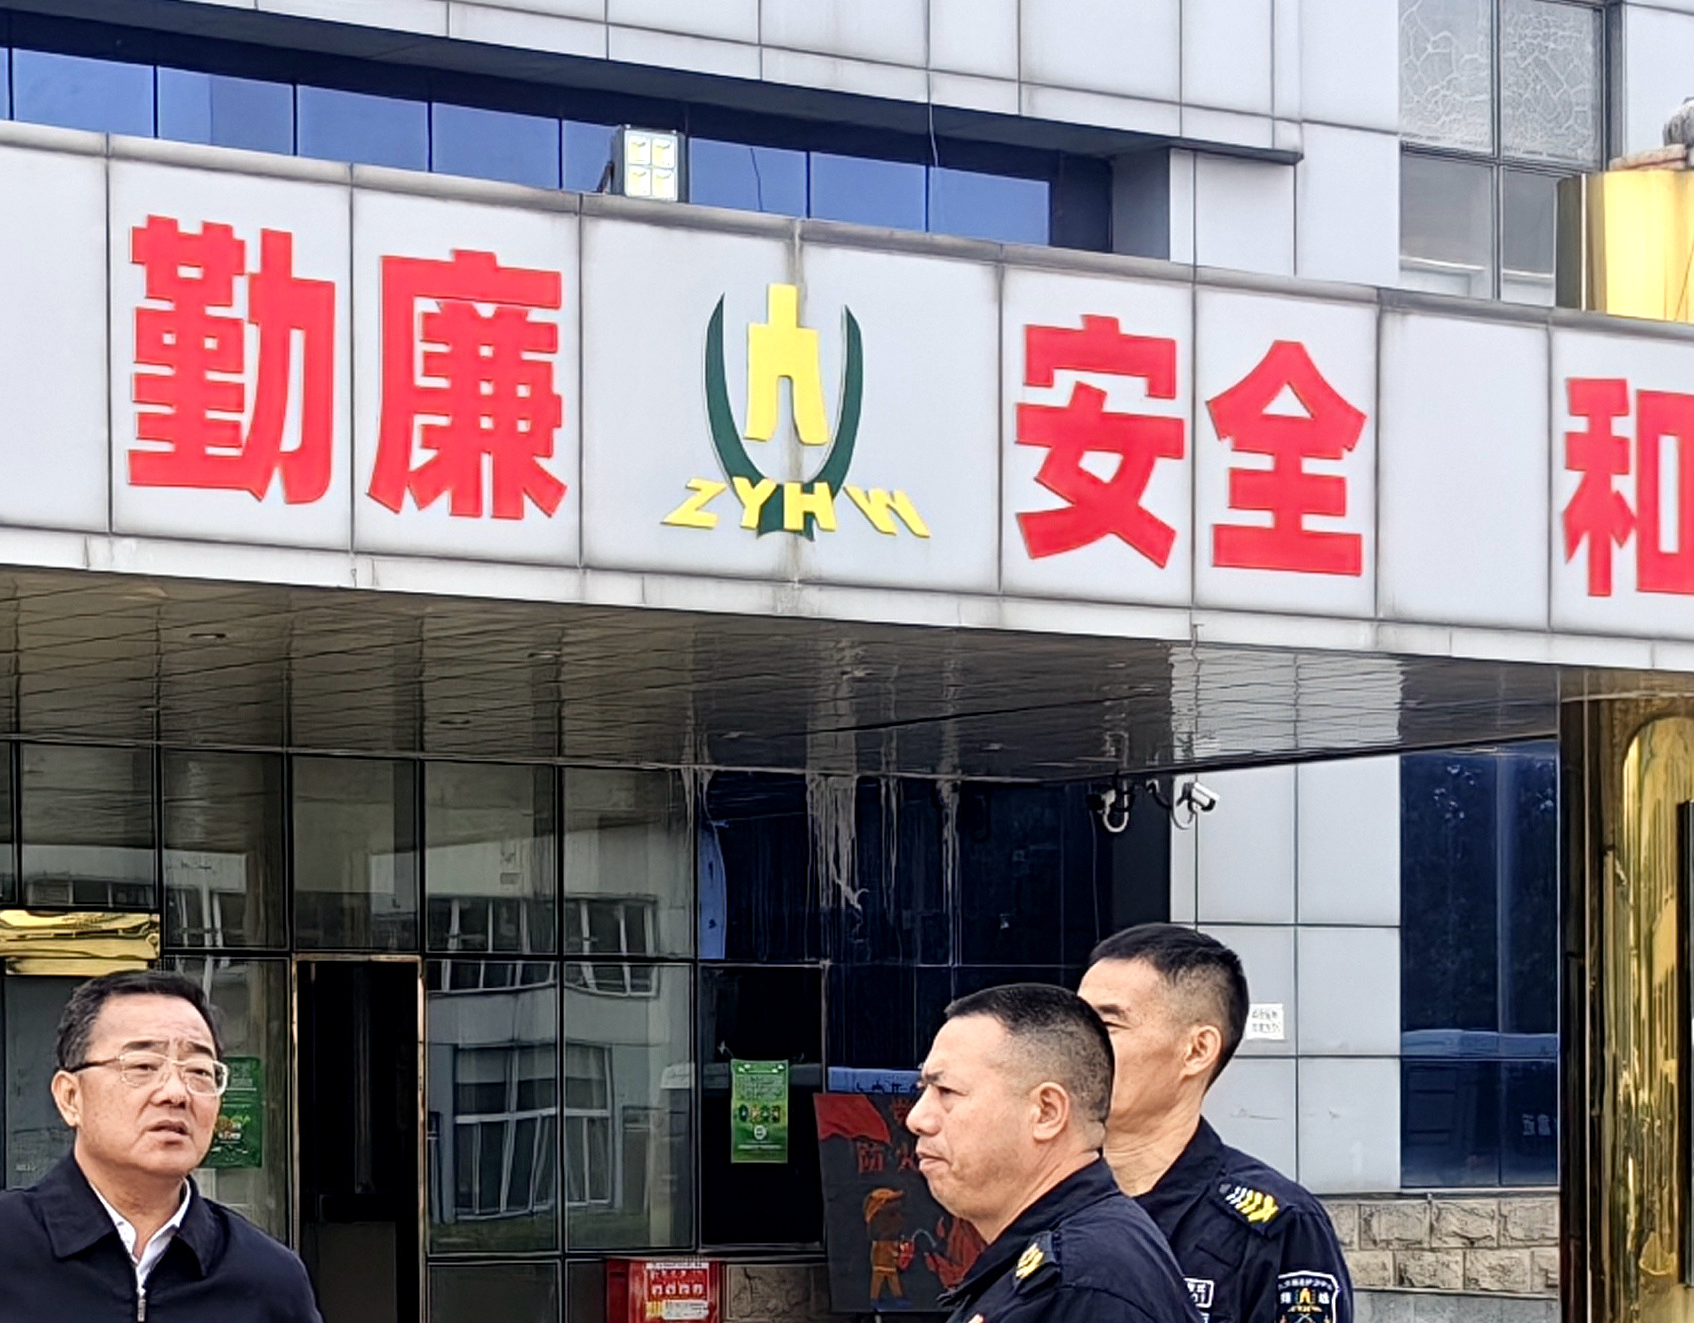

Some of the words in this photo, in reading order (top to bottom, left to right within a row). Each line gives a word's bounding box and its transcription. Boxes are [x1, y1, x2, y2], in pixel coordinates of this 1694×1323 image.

[128, 215, 566, 521] 勤廉
[1016, 314, 1366, 577] 安全
[1564, 379, 1694, 597] 和
[660, 476, 931, 538] ZYHW
